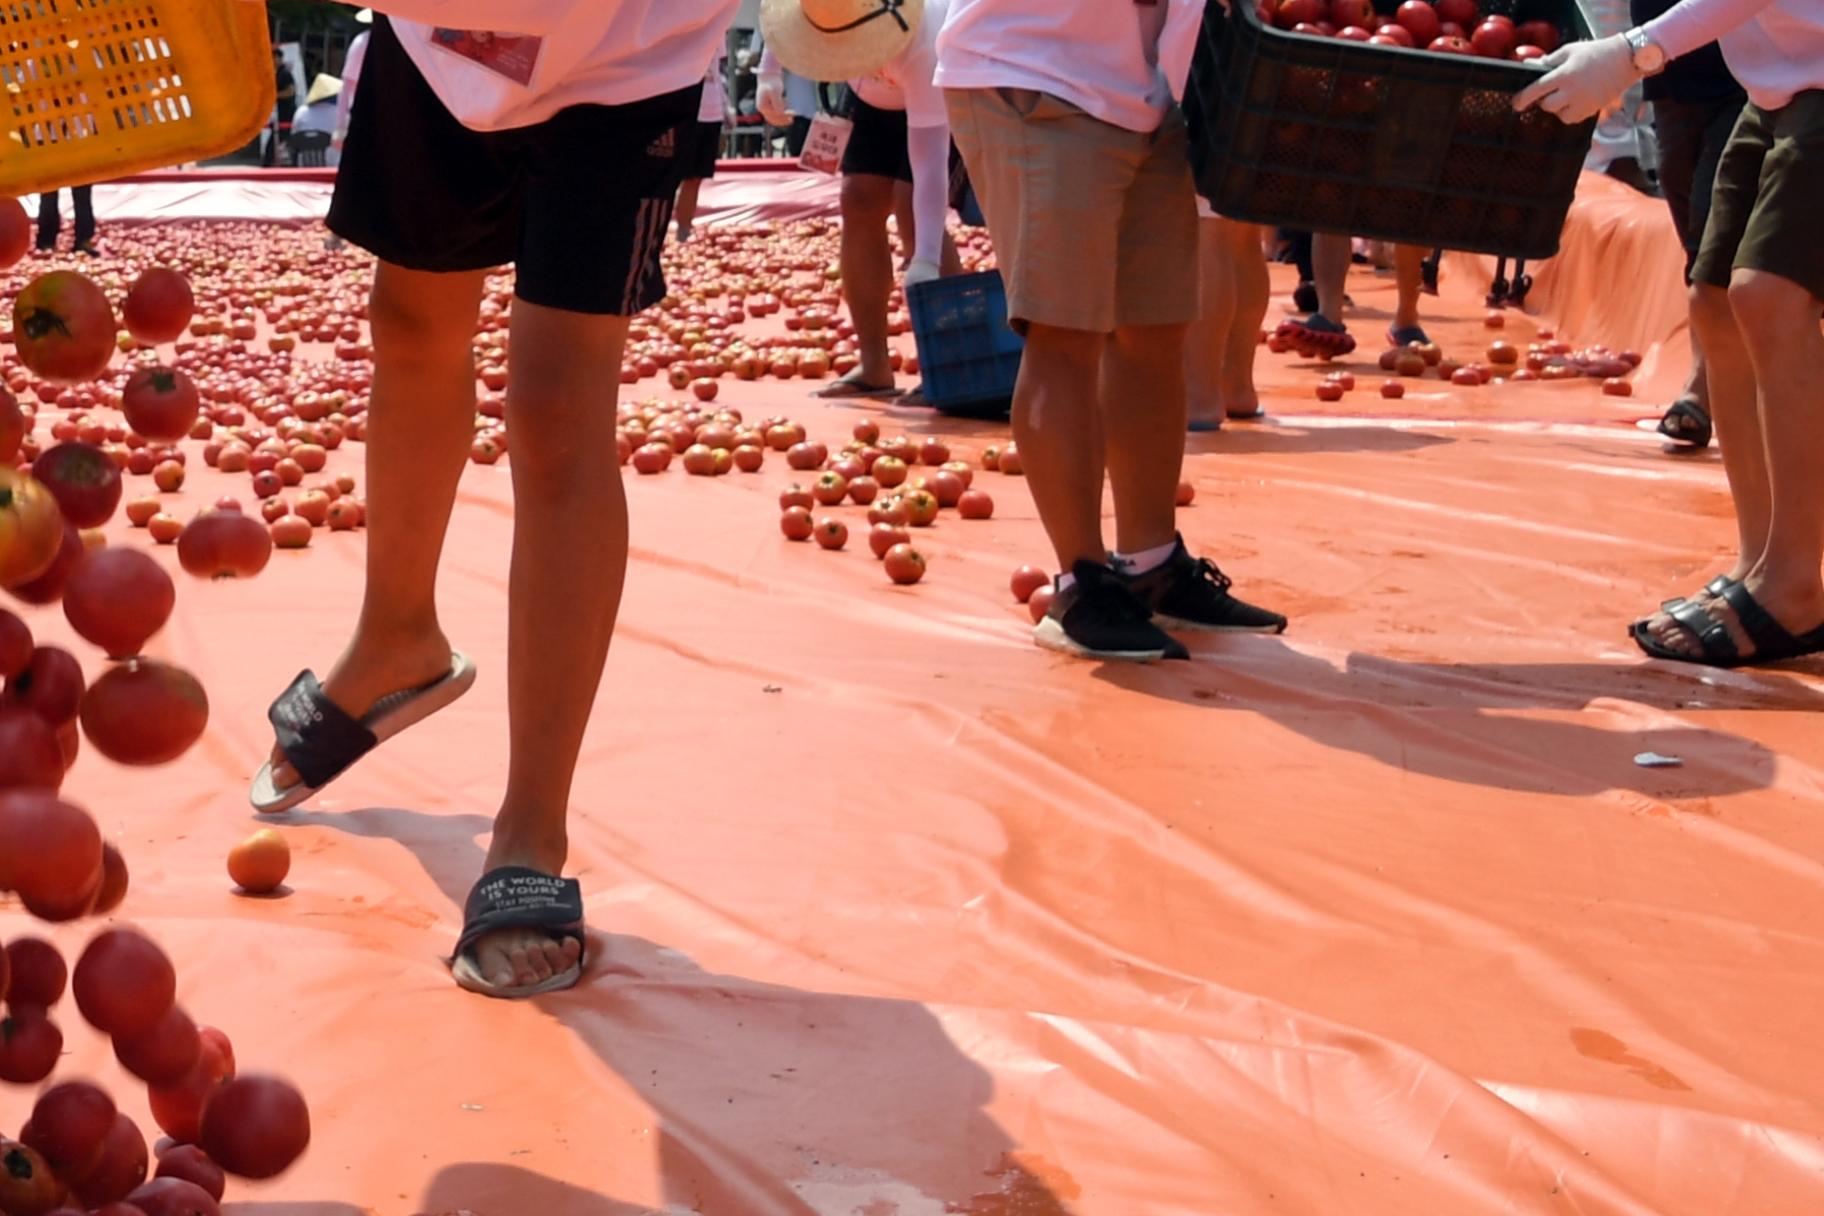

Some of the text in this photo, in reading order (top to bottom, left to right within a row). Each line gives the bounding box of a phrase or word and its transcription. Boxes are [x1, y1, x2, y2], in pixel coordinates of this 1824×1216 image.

[481, 877, 565, 895] THE WORLD
[488, 886, 559, 901] IS YOURS
